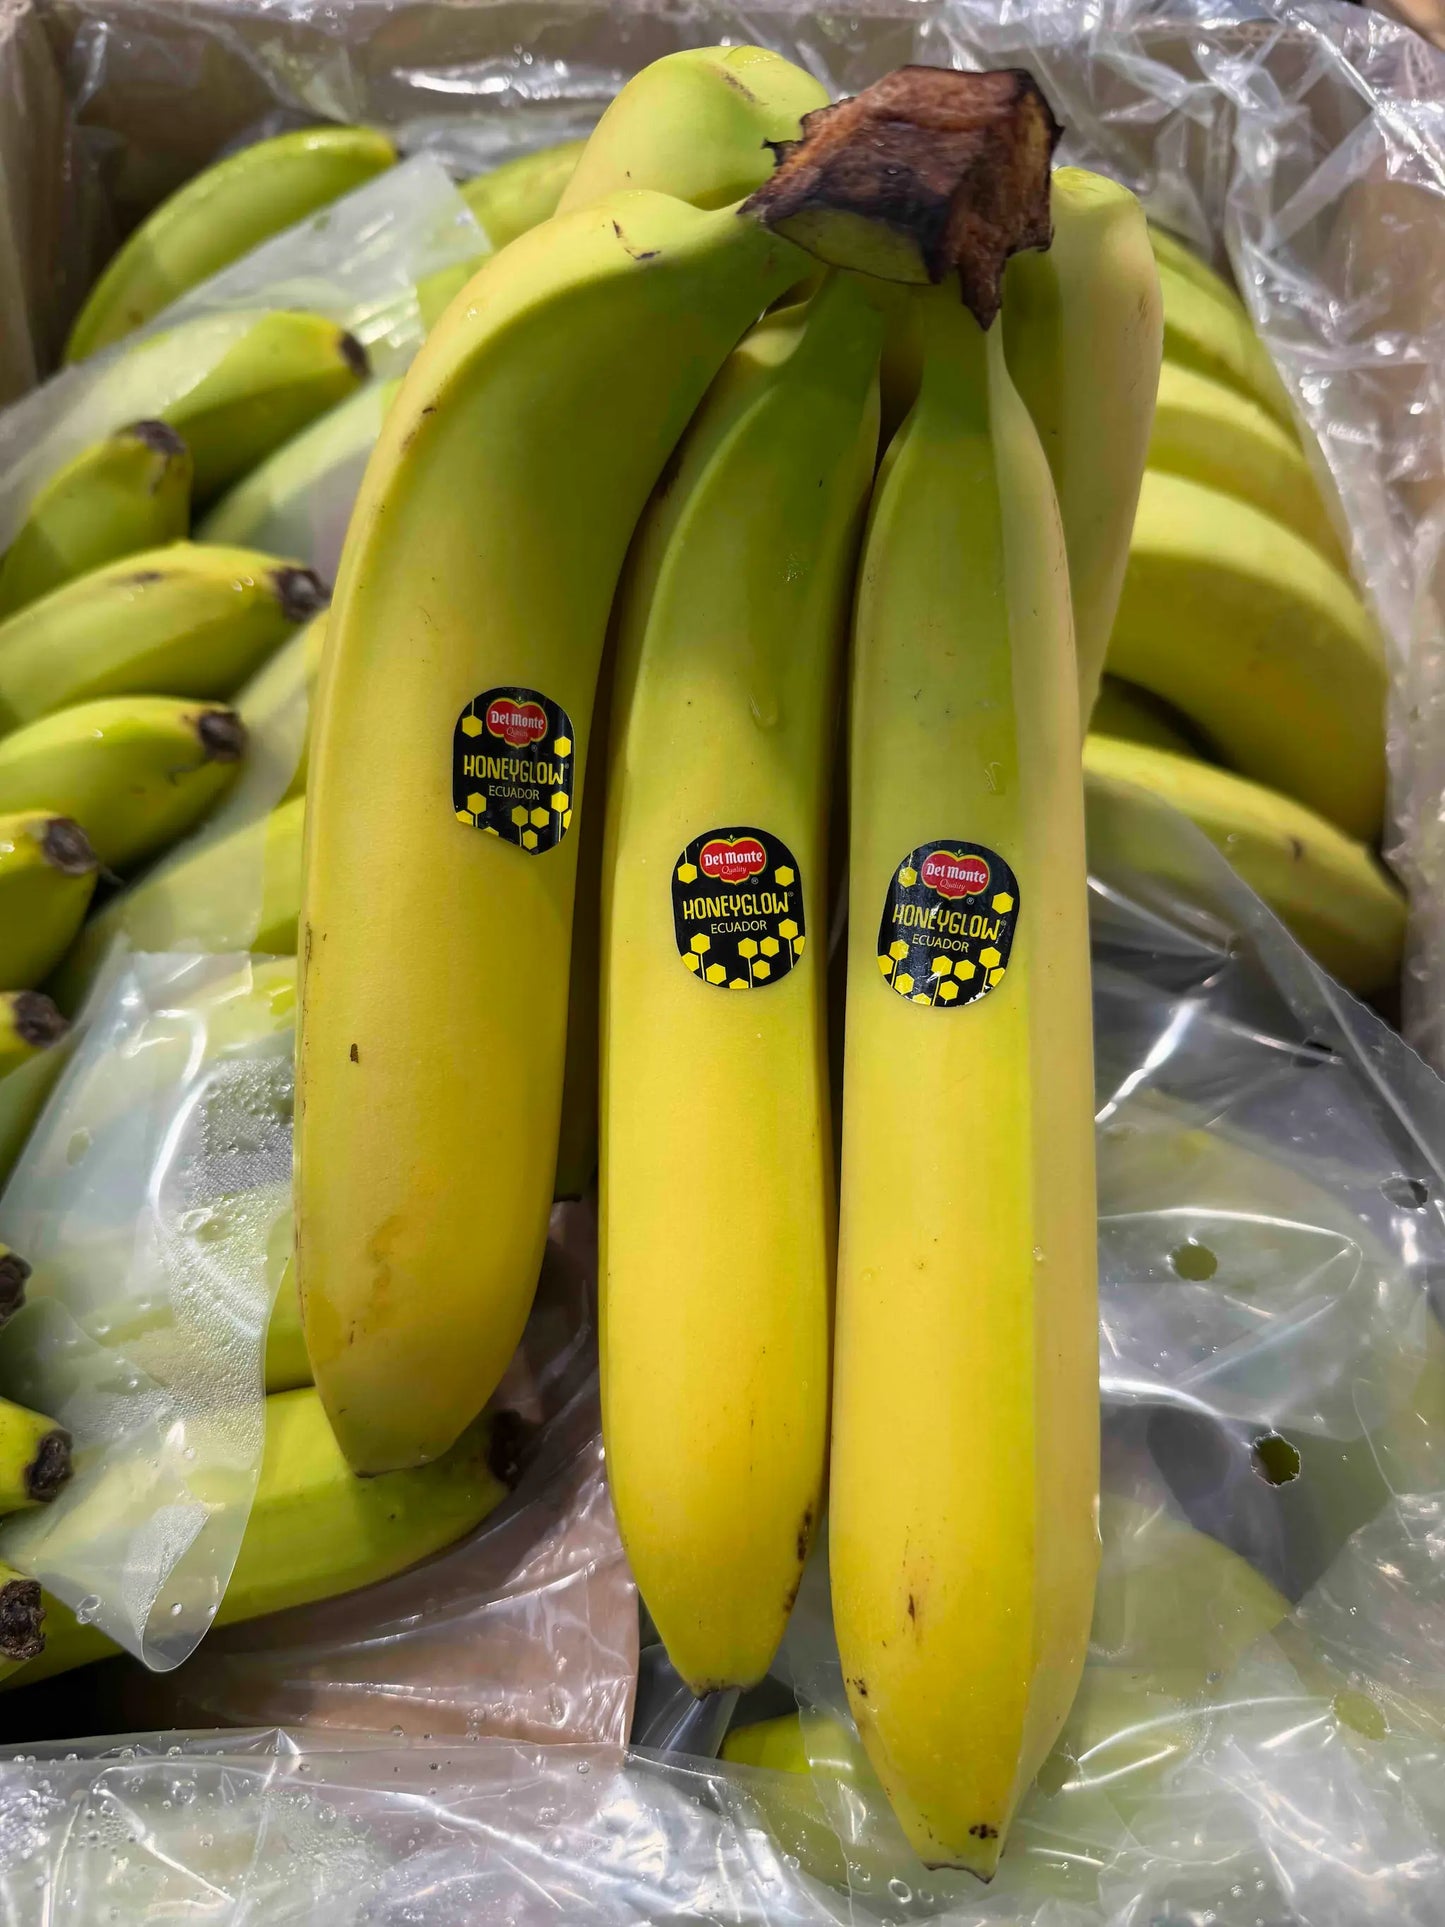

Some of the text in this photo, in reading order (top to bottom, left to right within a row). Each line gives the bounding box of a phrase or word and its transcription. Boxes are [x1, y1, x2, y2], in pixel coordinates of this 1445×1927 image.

[491, 710, 544, 729] Del Monte
[463, 755, 564, 785] HONEYGLOW
[488, 785, 540, 800] ECUADOR
[704, 850, 763, 866] Del Monte
[926, 863, 986, 883] Del Monte
[683, 892, 789, 920] HONEYGLOW
[710, 920, 767, 934] ECUADOR
[892, 904, 1000, 940] HONEYGLOW
[912, 933, 970, 953] ECUADOR
